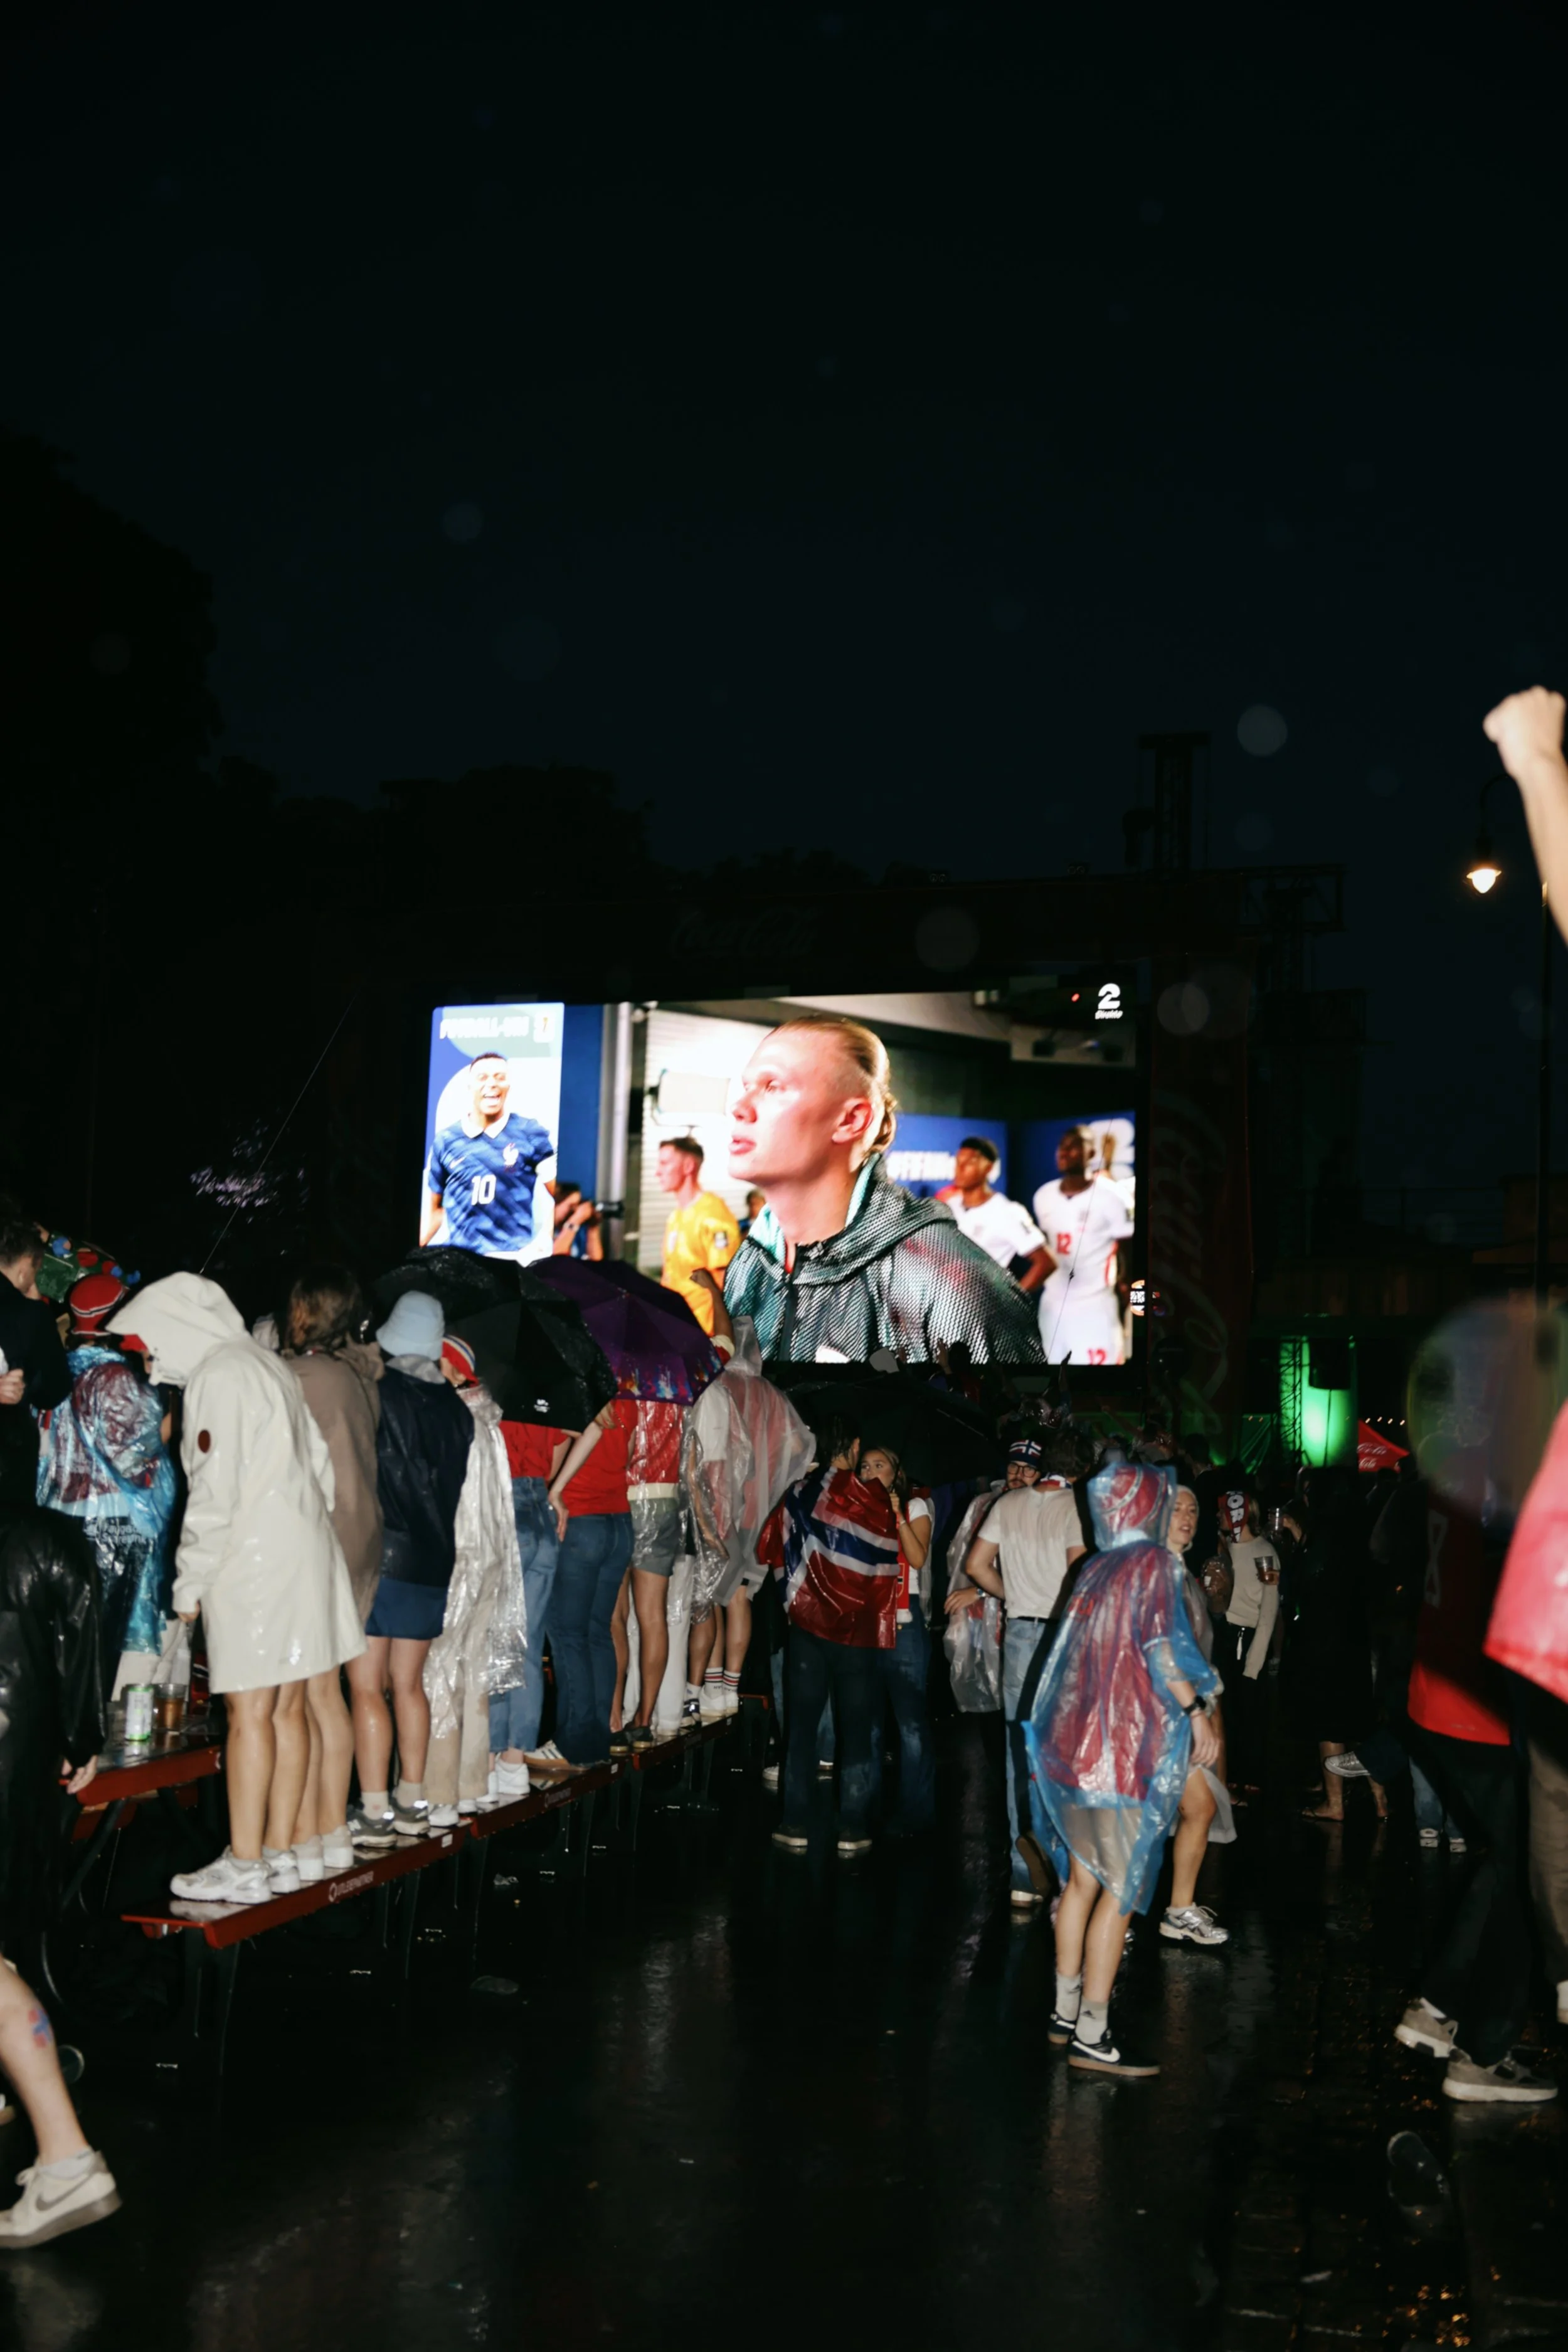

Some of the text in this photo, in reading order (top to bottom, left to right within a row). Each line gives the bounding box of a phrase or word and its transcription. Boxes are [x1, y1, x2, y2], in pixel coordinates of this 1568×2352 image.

[1098, 983, 1121, 1010] 2
[471, 1173, 497, 1205] 10
[1056, 1232, 1072, 1255] 12
